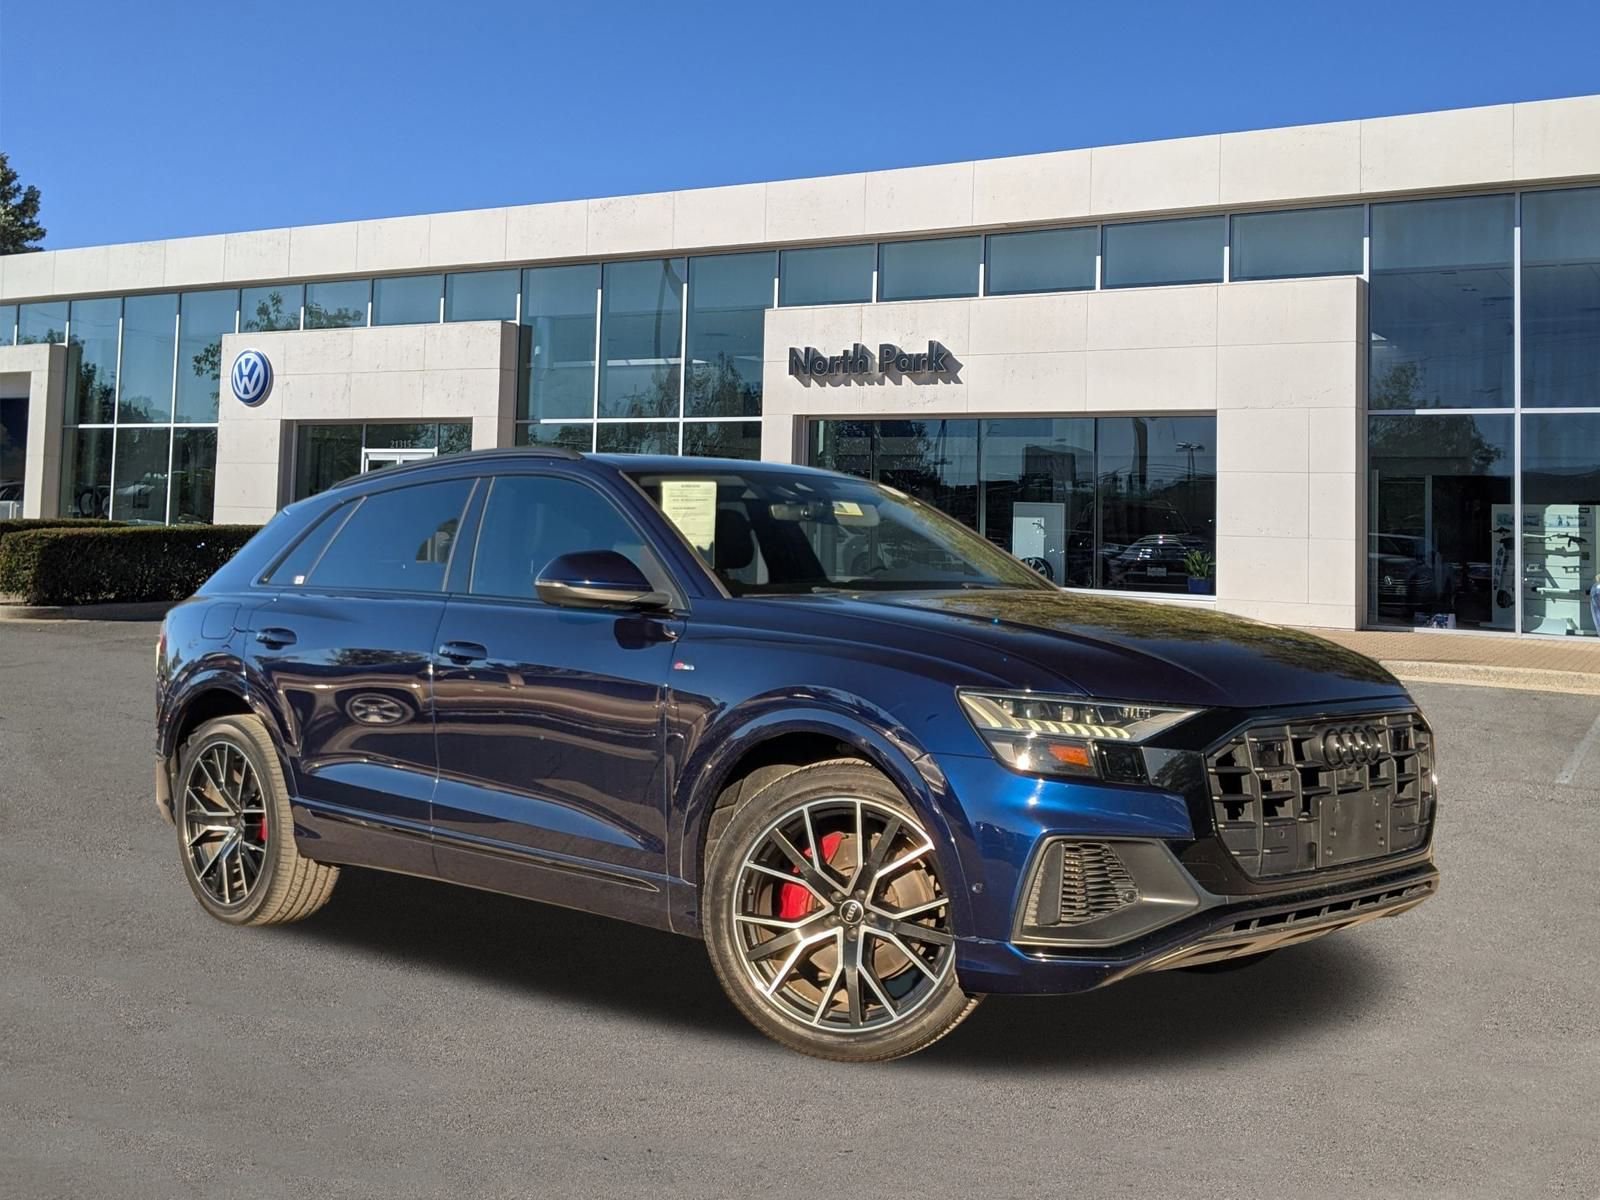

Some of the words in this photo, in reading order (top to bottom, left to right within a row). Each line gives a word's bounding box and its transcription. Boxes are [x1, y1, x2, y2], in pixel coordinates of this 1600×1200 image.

[232, 351, 267, 402] VW
[788, 342, 870, 376] North
[878, 340, 947, 373] Park
